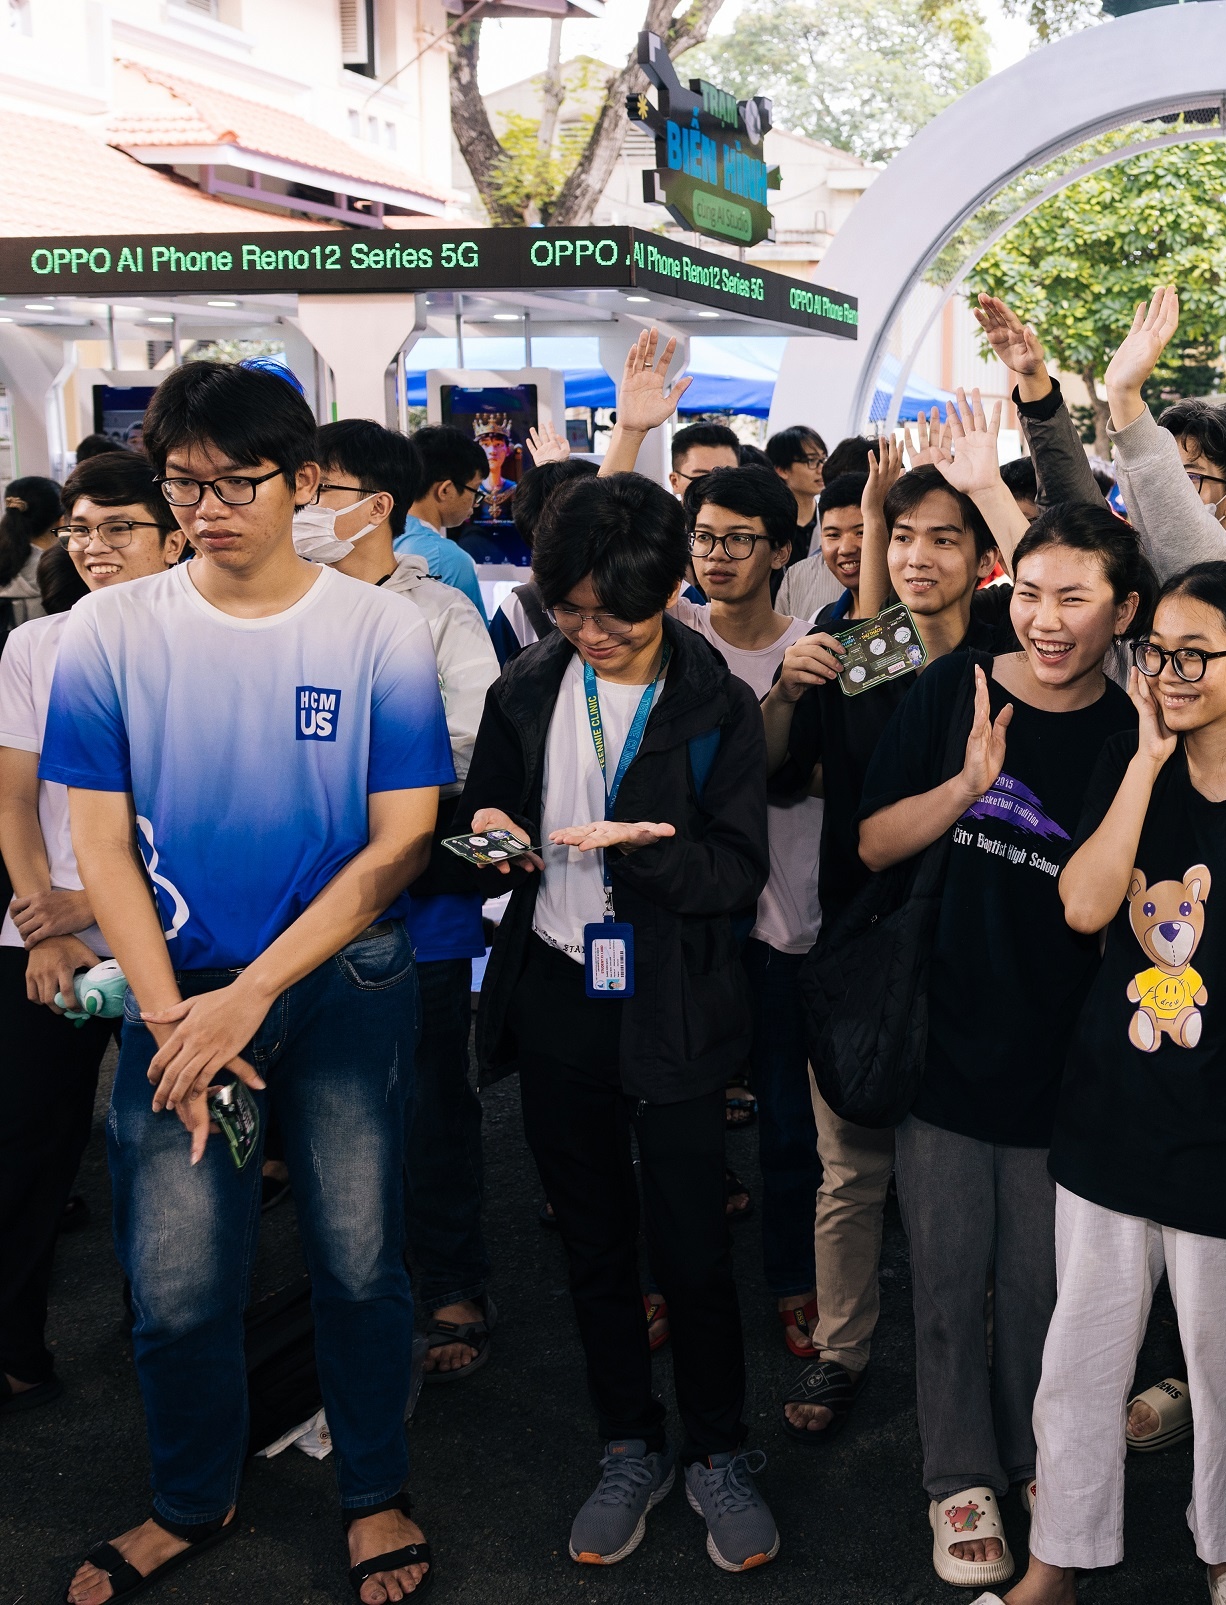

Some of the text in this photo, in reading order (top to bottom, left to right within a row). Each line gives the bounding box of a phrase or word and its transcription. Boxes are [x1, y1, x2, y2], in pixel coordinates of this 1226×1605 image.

[666, 107, 768, 206] BIẾN HÌNH
[31, 241, 479, 274] OPPO AI Phone Reno12 Series 5G
[530, 239, 764, 301] OPPO AI Phone Reno12 Series 5G
[789, 287, 814, 313] OPPO
[813, 294, 822, 316] AI
[822, 296, 843, 322] Phone
[300, 690, 337, 711] HCM
[587, 695, 600, 727] CLINIC
[300, 709, 333, 737] US
[995, 776, 1014, 790] 2015
[976, 794, 1040, 827] asketball tradition
[953, 827, 1060, 877] City Baptist High School
[1160, 998, 1180, 1007] drew
